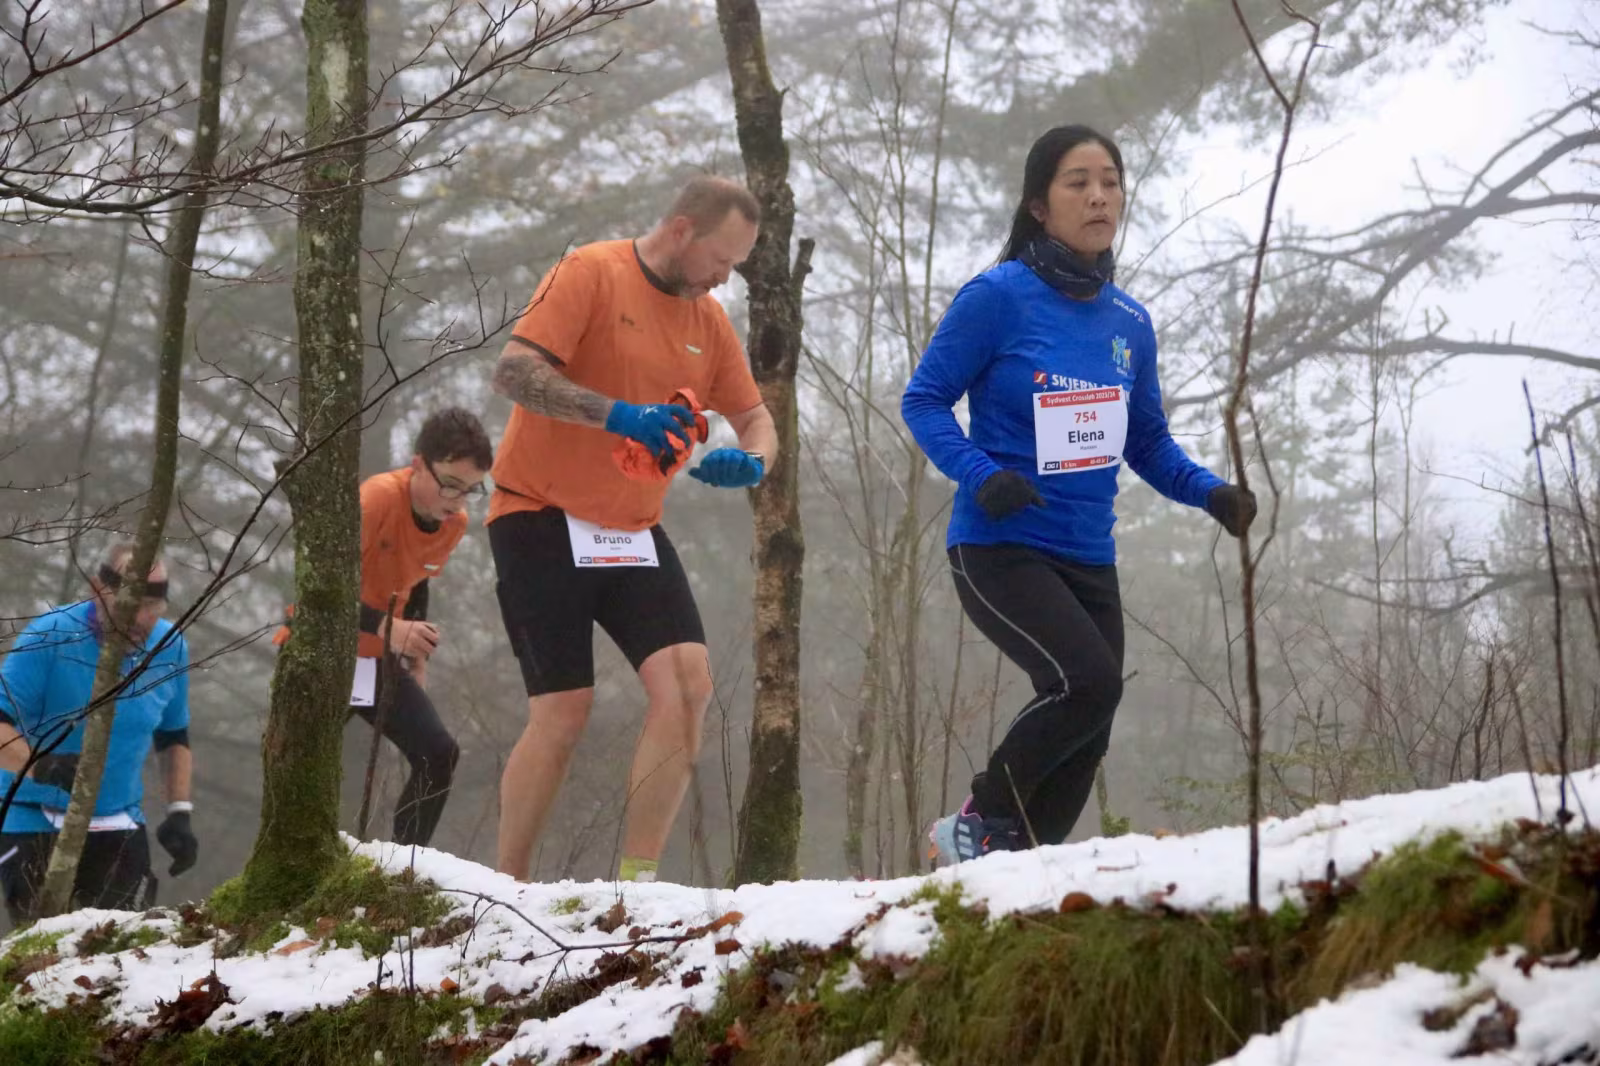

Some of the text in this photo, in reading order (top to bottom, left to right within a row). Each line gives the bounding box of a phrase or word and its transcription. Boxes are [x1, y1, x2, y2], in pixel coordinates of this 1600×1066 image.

[1074, 411, 1097, 423] 754
[1068, 430, 1105, 443] Elena
[593, 534, 632, 544] Bruno
